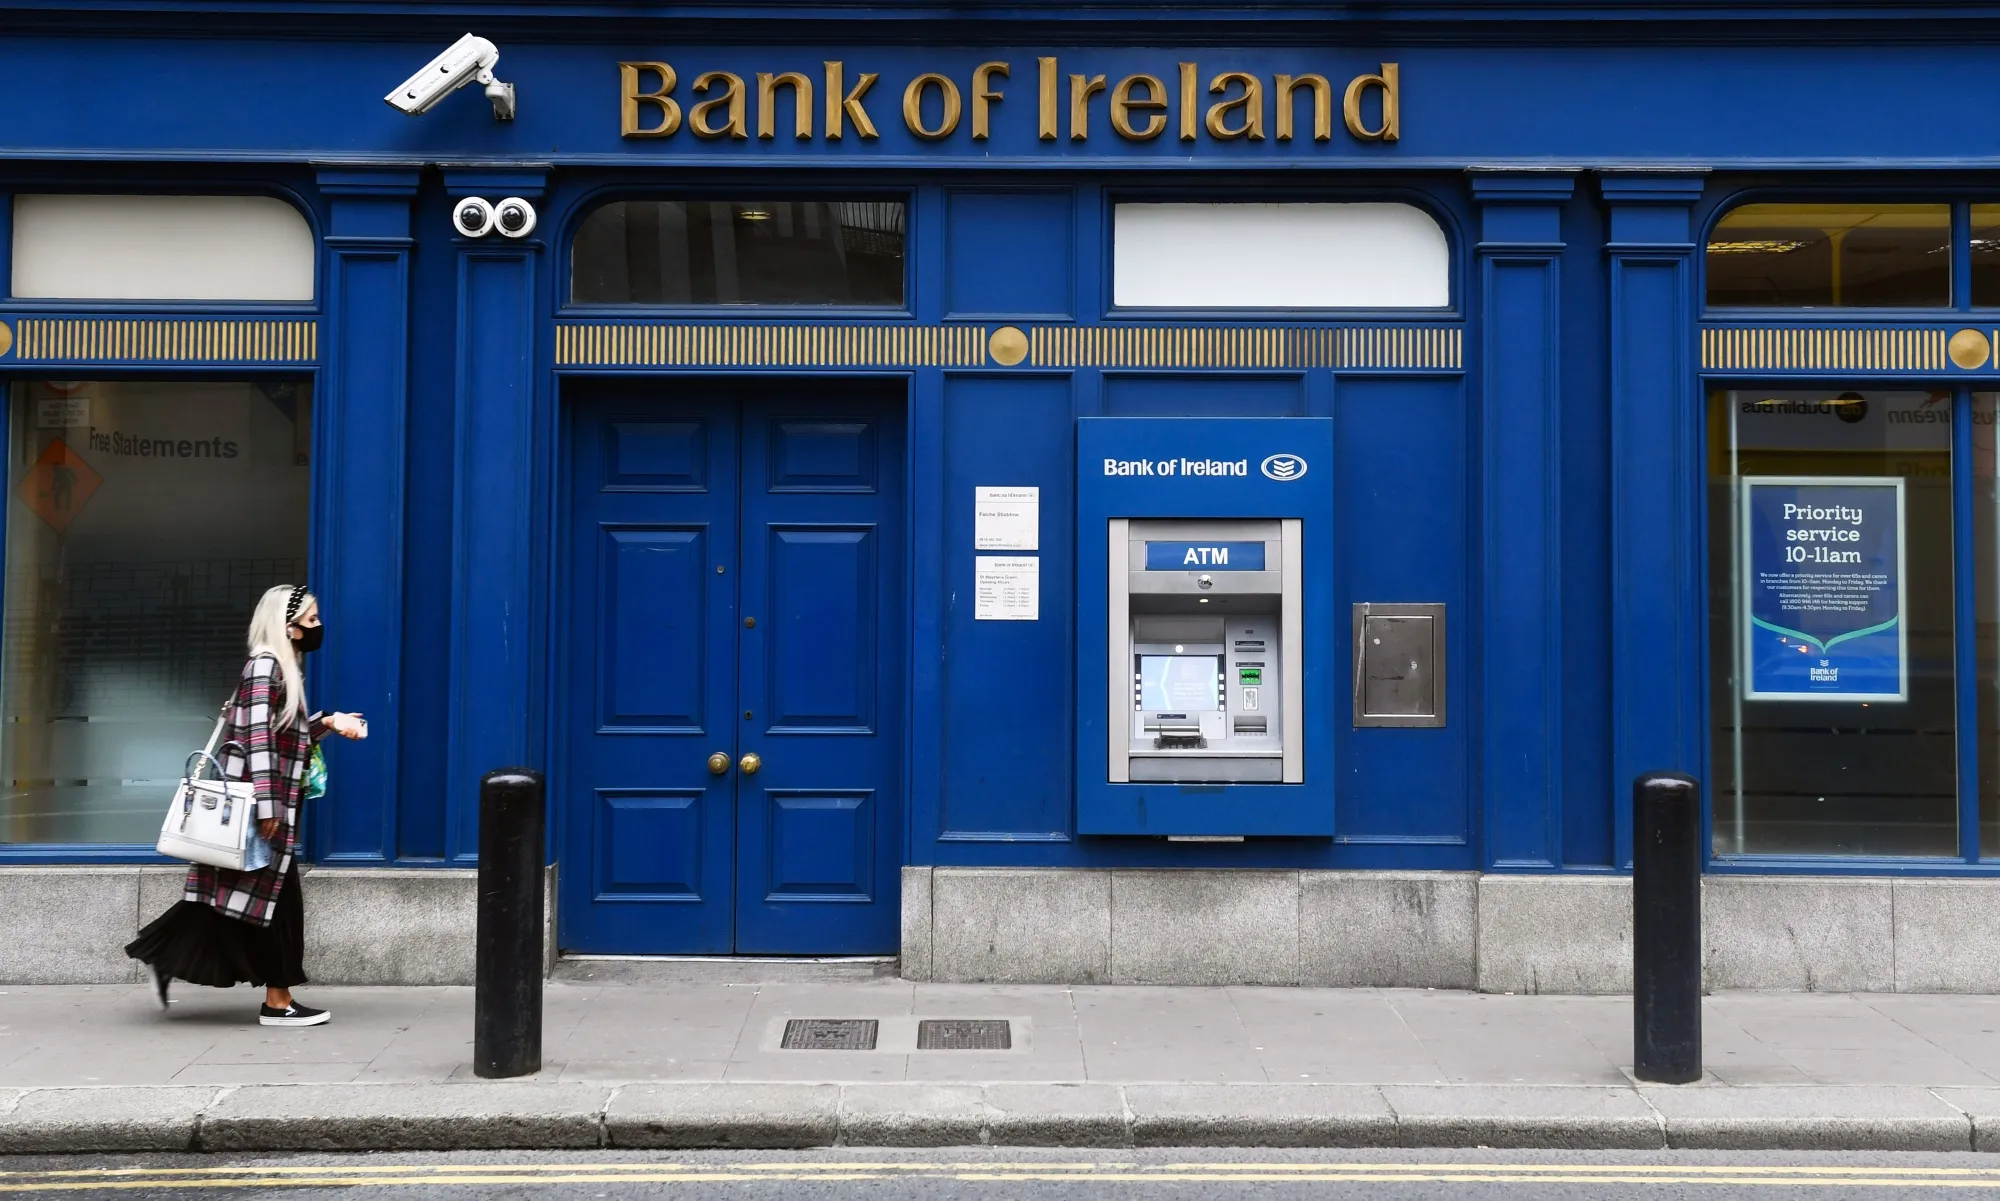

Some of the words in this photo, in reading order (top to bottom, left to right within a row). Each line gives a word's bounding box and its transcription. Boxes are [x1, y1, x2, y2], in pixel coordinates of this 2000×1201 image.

[616, 60, 880, 139] Bank
[902, 61, 1010, 140] of
[1037, 56, 1401, 142] Ireland
[89, 426, 110, 452] Free
[113, 431, 238, 458] Statements
[1104, 458, 1154, 477] Bank
[1157, 458, 1177, 477] of
[1181, 457, 1248, 477] Ireland
[1783, 503, 1862, 526] Priority
[1786, 526, 1860, 542] service
[1183, 547, 1229, 565] ATM
[1785, 545, 1862, 563] 10-11am
[1810, 667, 1829, 675] Bank
[1830, 667, 1839, 675] of
[1810, 674, 1838, 682] Ireland
